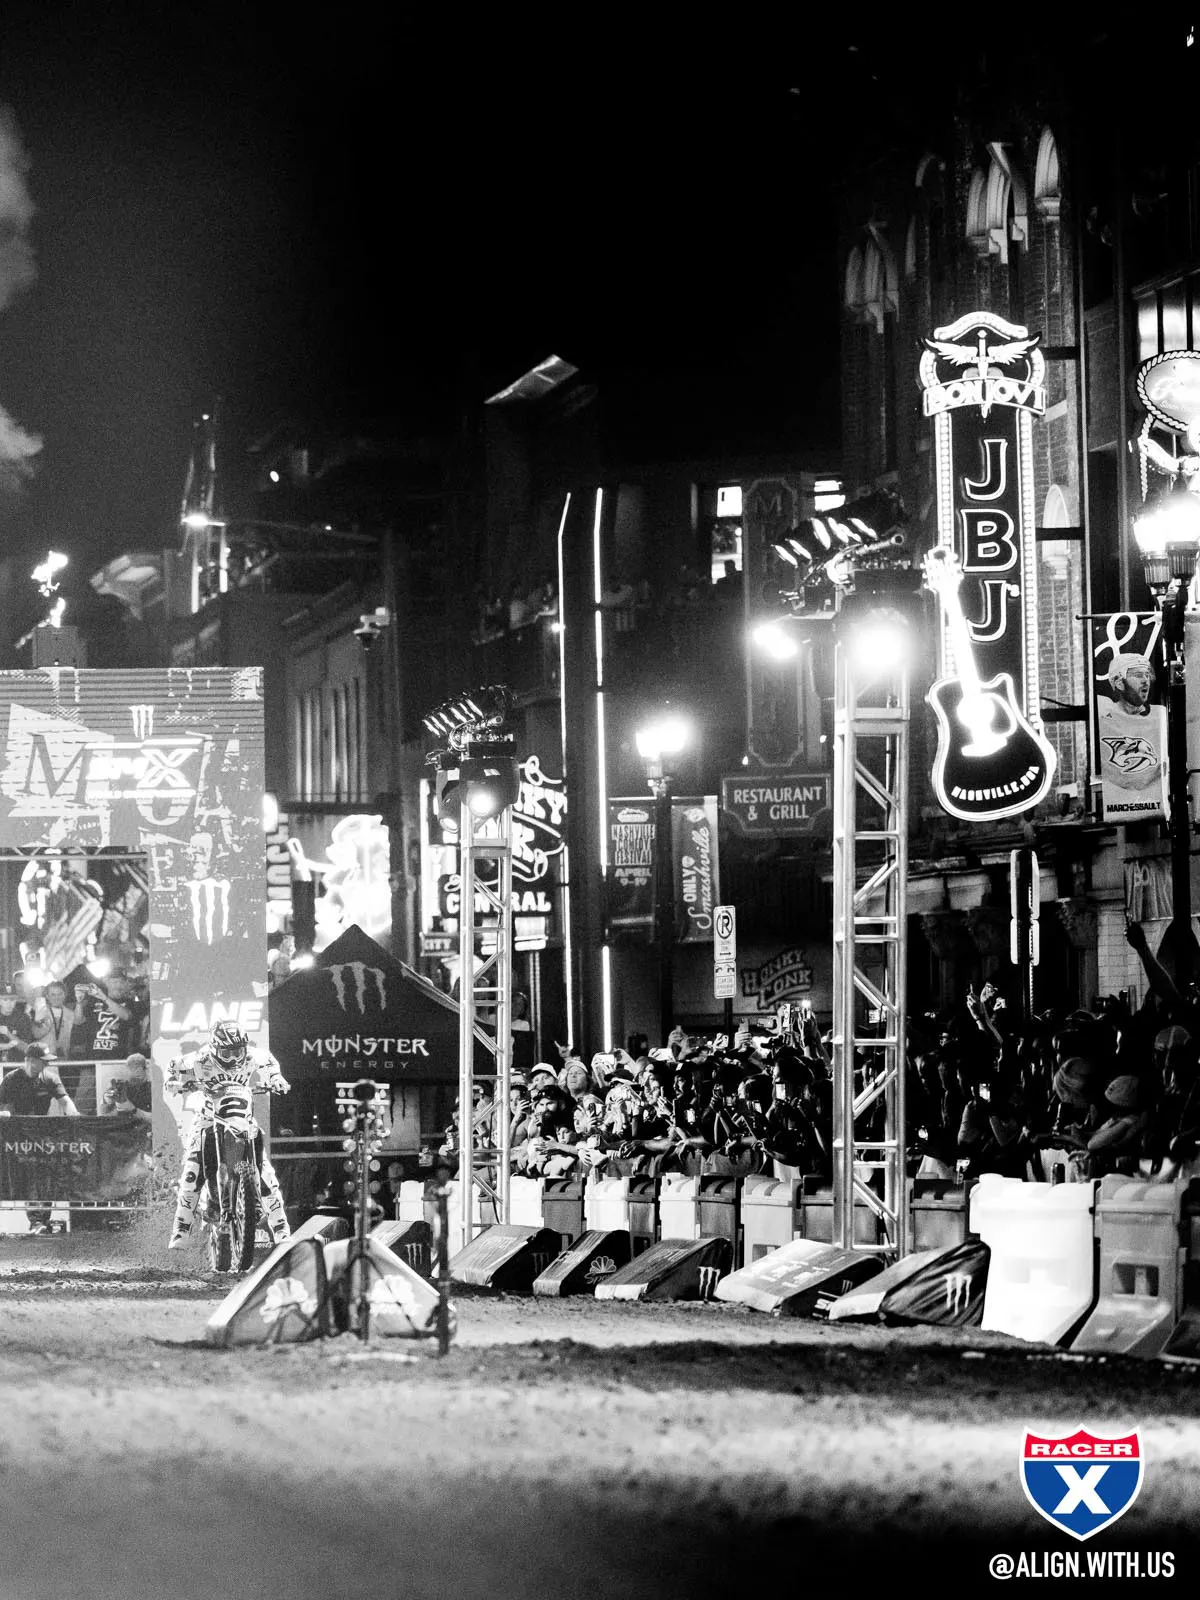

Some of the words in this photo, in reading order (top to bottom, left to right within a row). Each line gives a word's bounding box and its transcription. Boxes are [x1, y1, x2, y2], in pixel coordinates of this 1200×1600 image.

[734, 786, 822, 803] RESTAURANT
[747, 805, 758, 820] &
[769, 804, 810, 820] GRILL
[1106, 802, 1161, 812] MARCHESSAULT
[682, 870, 697, 902] ONLY
[688, 826, 712, 929] Smashville
[160, 1001, 264, 1032] LANE
[301, 1036, 430, 1057] MONSTER
[321, 1061, 410, 1069] ENERGY
[218, 1096, 249, 1119] 2
[5, 1139, 94, 1154] MONSTER
